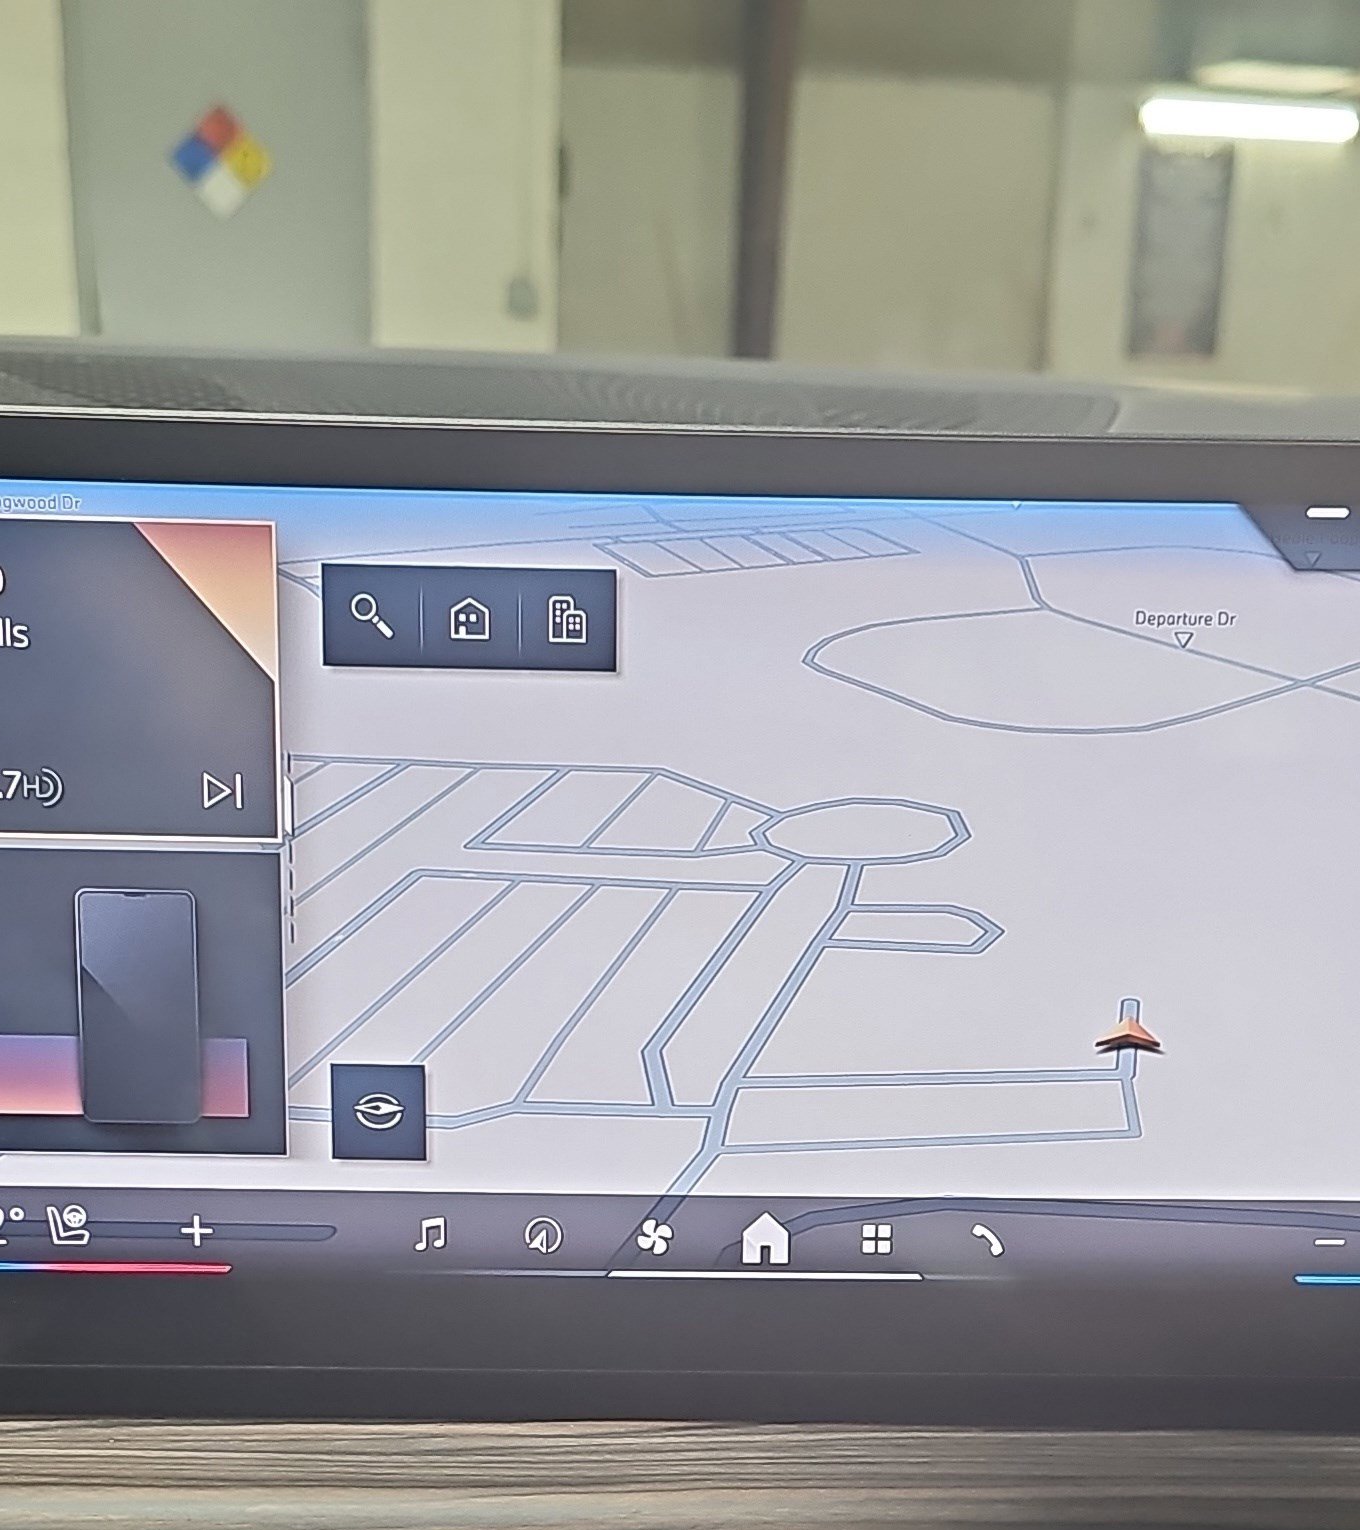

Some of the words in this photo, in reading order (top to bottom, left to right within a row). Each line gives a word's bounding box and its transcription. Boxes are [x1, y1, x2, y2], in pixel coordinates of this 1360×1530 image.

[62, 495, 81, 510] Dr
[1135, 610, 1213, 629] Departure
[1217, 611, 1237, 627] Dr
